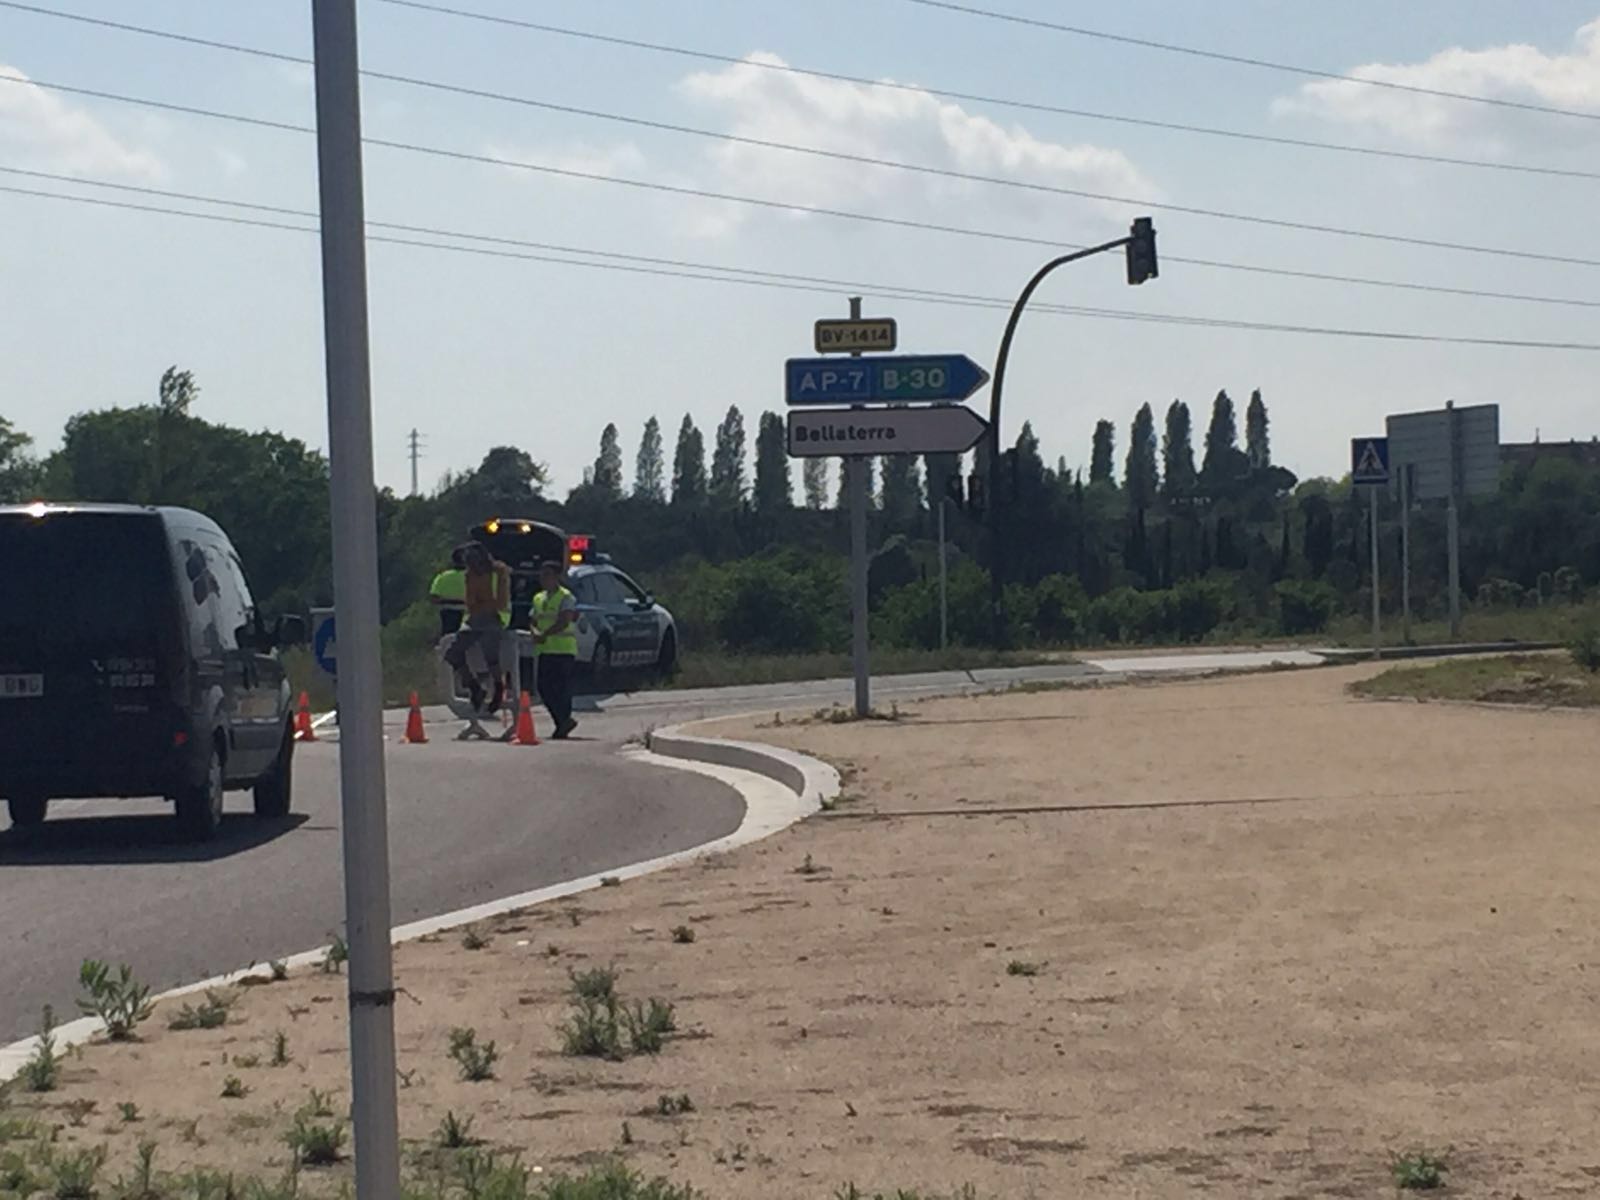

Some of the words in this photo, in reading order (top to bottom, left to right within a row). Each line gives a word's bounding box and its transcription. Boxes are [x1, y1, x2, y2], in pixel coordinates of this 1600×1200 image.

[822, 329, 888, 343] BV-1414
[801, 372, 864, 391] AP-7
[883, 368, 944, 389] B-30
[795, 425, 896, 441] Bellaterra
